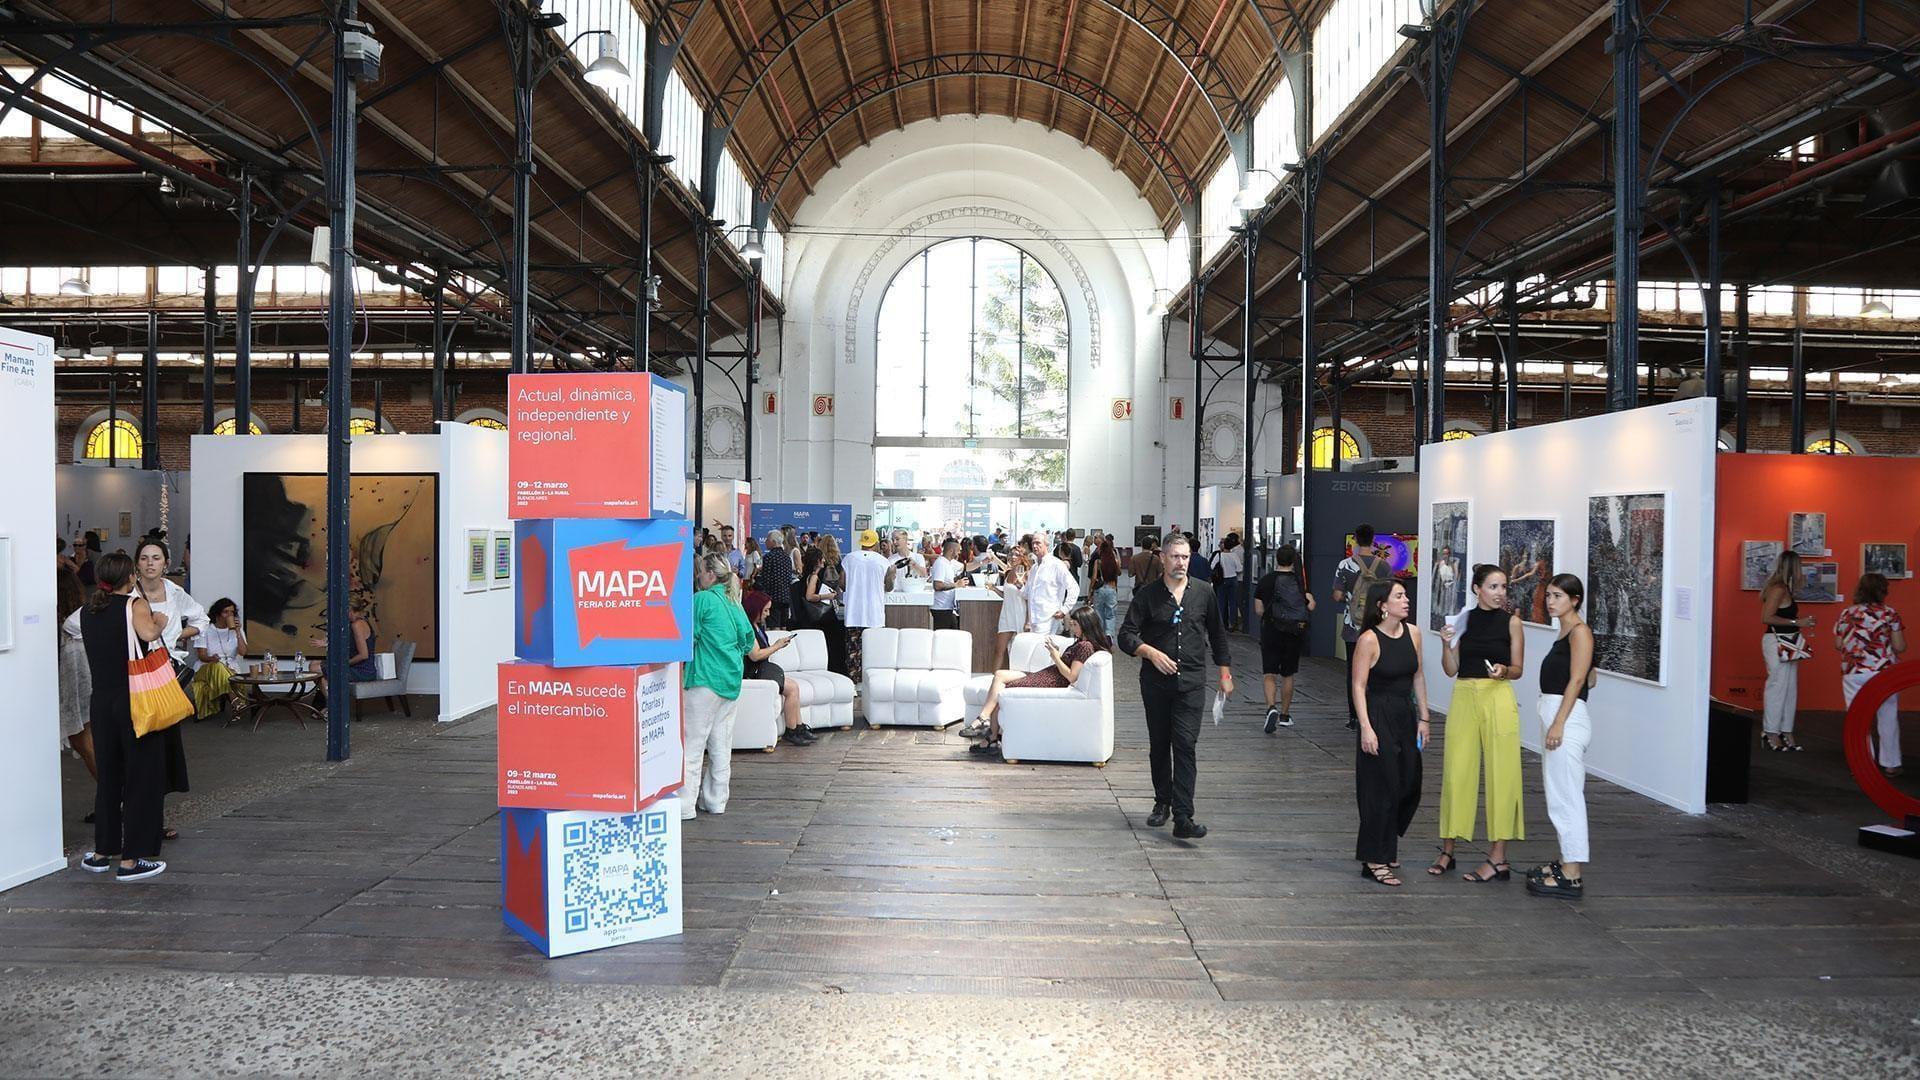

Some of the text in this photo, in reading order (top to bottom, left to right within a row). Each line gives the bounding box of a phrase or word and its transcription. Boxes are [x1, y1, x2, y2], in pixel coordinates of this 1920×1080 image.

[4, 353, 35, 366] Maman
[1, 362, 35, 376] Fine Art
[517, 387, 636, 403] Actual, dinámica,
[517, 407, 631, 425] independiente y
[517, 426, 577, 446] regional.
[578, 570, 668, 598] MAPA
[578, 599, 642, 609] FERIA DE ARTE
[508, 680, 627, 698] En MAPA sucede
[508, 701, 609, 718] el intercambio.
[641, 697, 661, 713] Charlas
[641, 710, 671, 729] encuentros
[641, 725, 665, 746] en MAPA
[532, 771, 557, 779] marzo
[603, 863, 630, 875] MAPA
